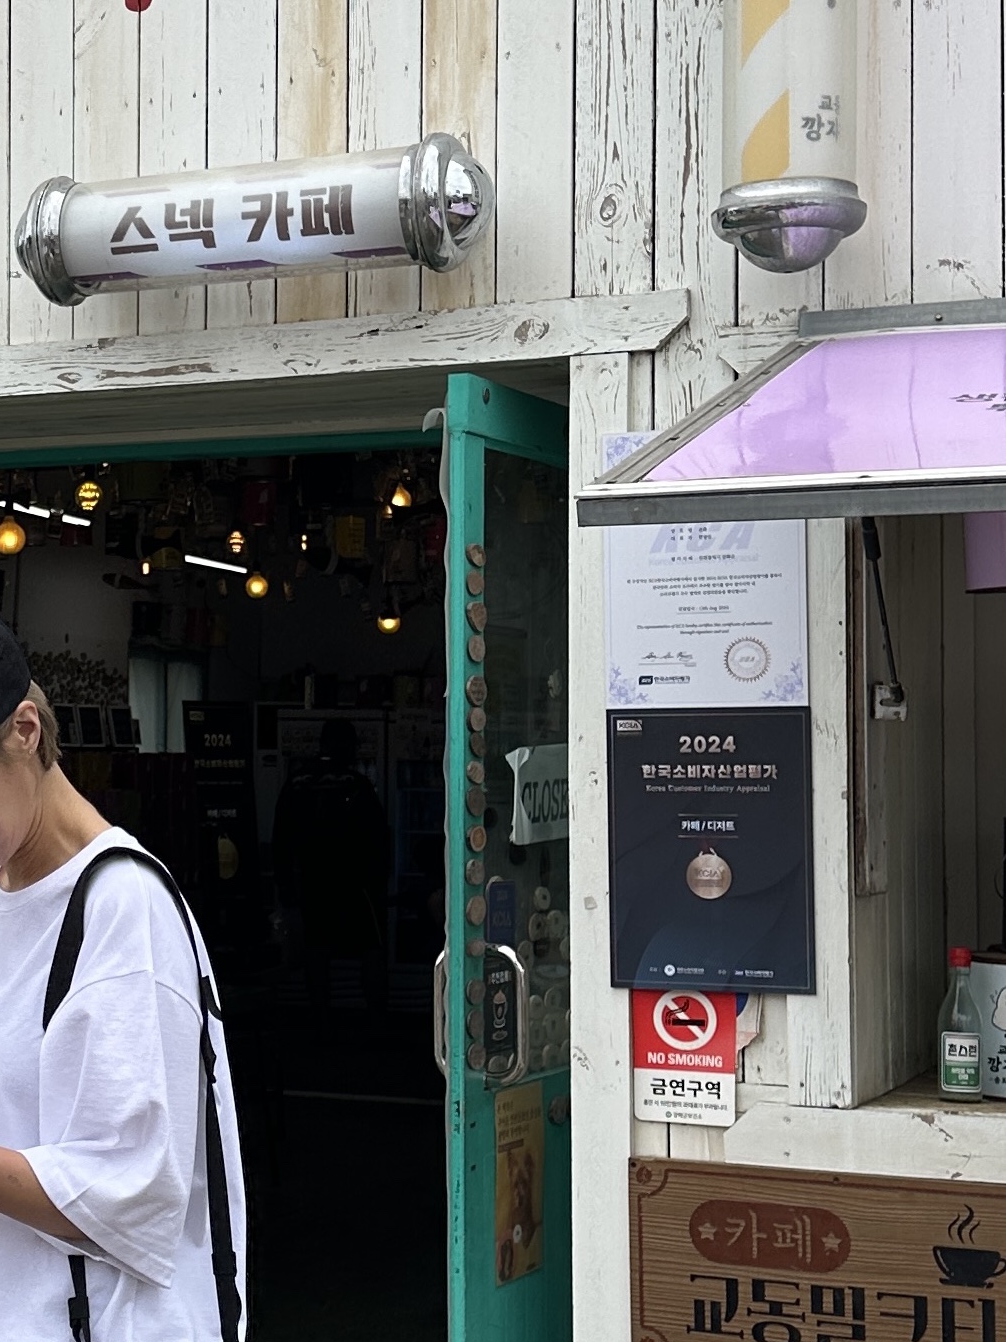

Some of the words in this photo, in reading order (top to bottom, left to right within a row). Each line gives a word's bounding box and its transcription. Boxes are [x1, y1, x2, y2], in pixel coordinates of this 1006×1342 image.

[818, 95, 840, 114] 교
[110, 199, 216, 255] 스넥
[241, 184, 355, 242] 카페
[204, 733, 233, 748] 2024
[679, 735, 736, 753] 2024
[641, 764, 778, 780] 한국소비자산업평가
[704, 785, 734, 794] Industry
[736, 785, 770, 793] Appraisal
[647, 1052, 665, 1064] NO
[667, 1053, 723, 1068] SMOKING
[650, 1077, 721, 1100] 금연구역
[724, 1209, 812, 1265] 카페
